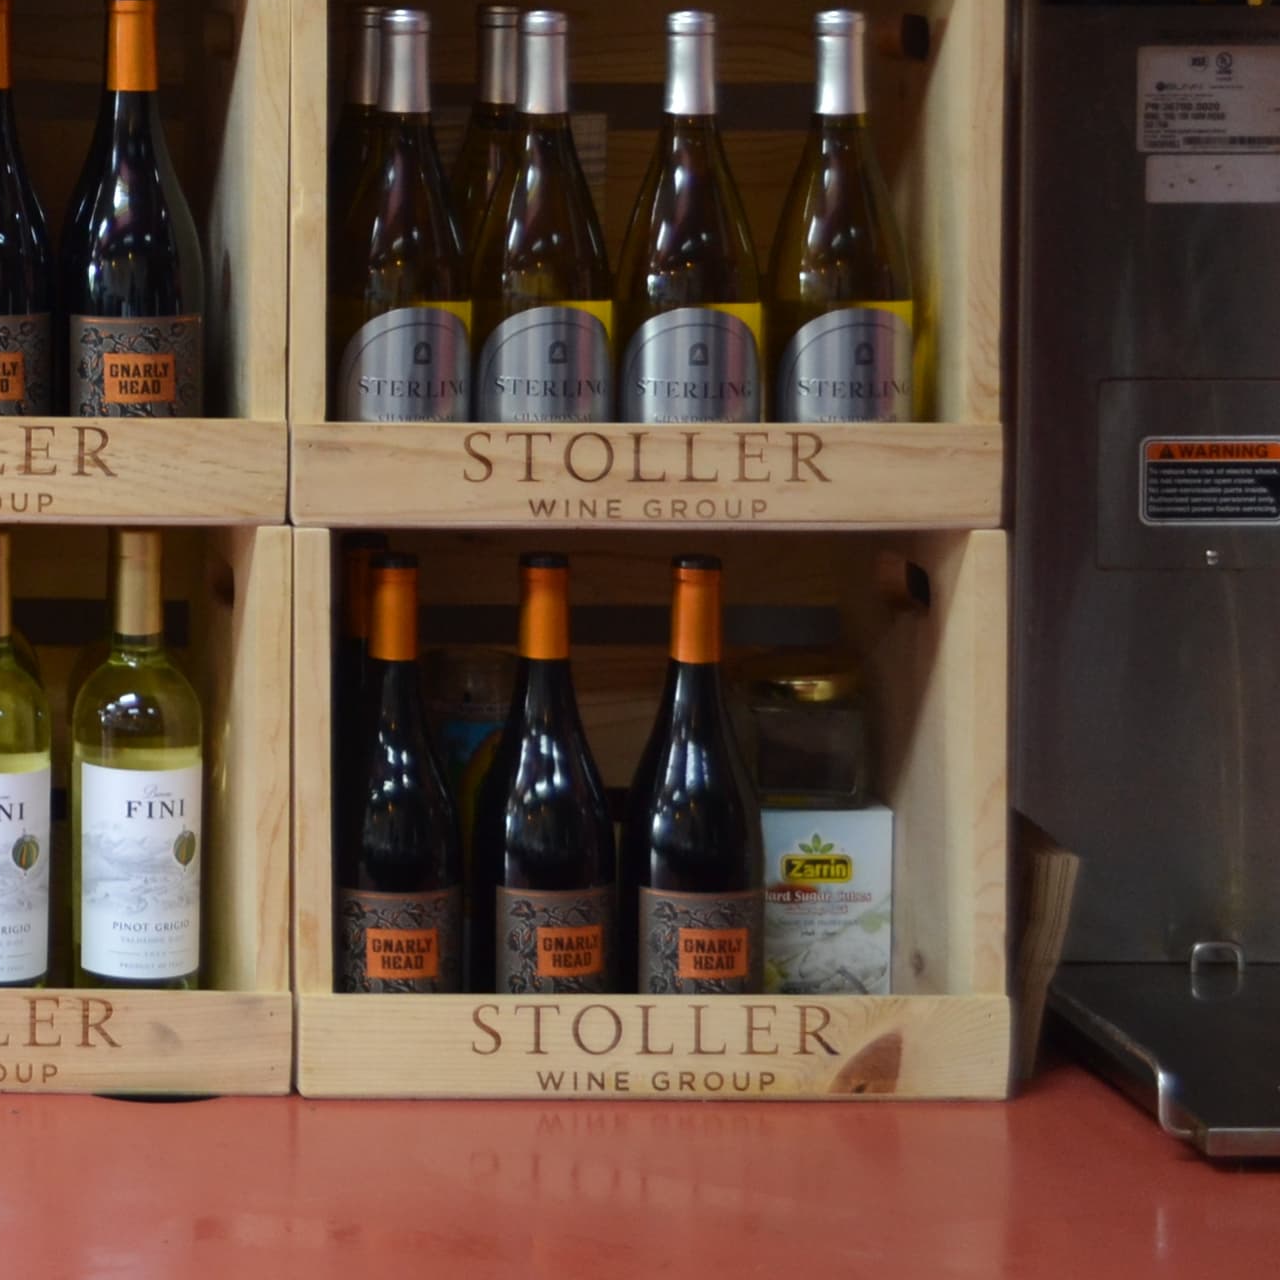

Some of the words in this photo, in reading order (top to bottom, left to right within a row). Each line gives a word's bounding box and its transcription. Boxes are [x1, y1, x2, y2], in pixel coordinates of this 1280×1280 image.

[109, 363, 169, 378] GNARLY
[118, 380, 161, 395] HEAD
[636, 379, 751, 400] STERLING
[462, 431, 831, 484] STOLLER
[1180, 444, 1269, 458] WARNING
[528, 498, 622, 519] WINE
[644, 498, 769, 519] GROUP
[125, 799, 185, 819] FINI
[790, 860, 848, 879] Zarrin
[372, 937, 433, 954] GNARLY
[381, 955, 424, 969] HEAD
[470, 1003, 841, 1056] STOLLER
[536, 1070, 631, 1092] WINE
[652, 1070, 776, 1092] GROUP
